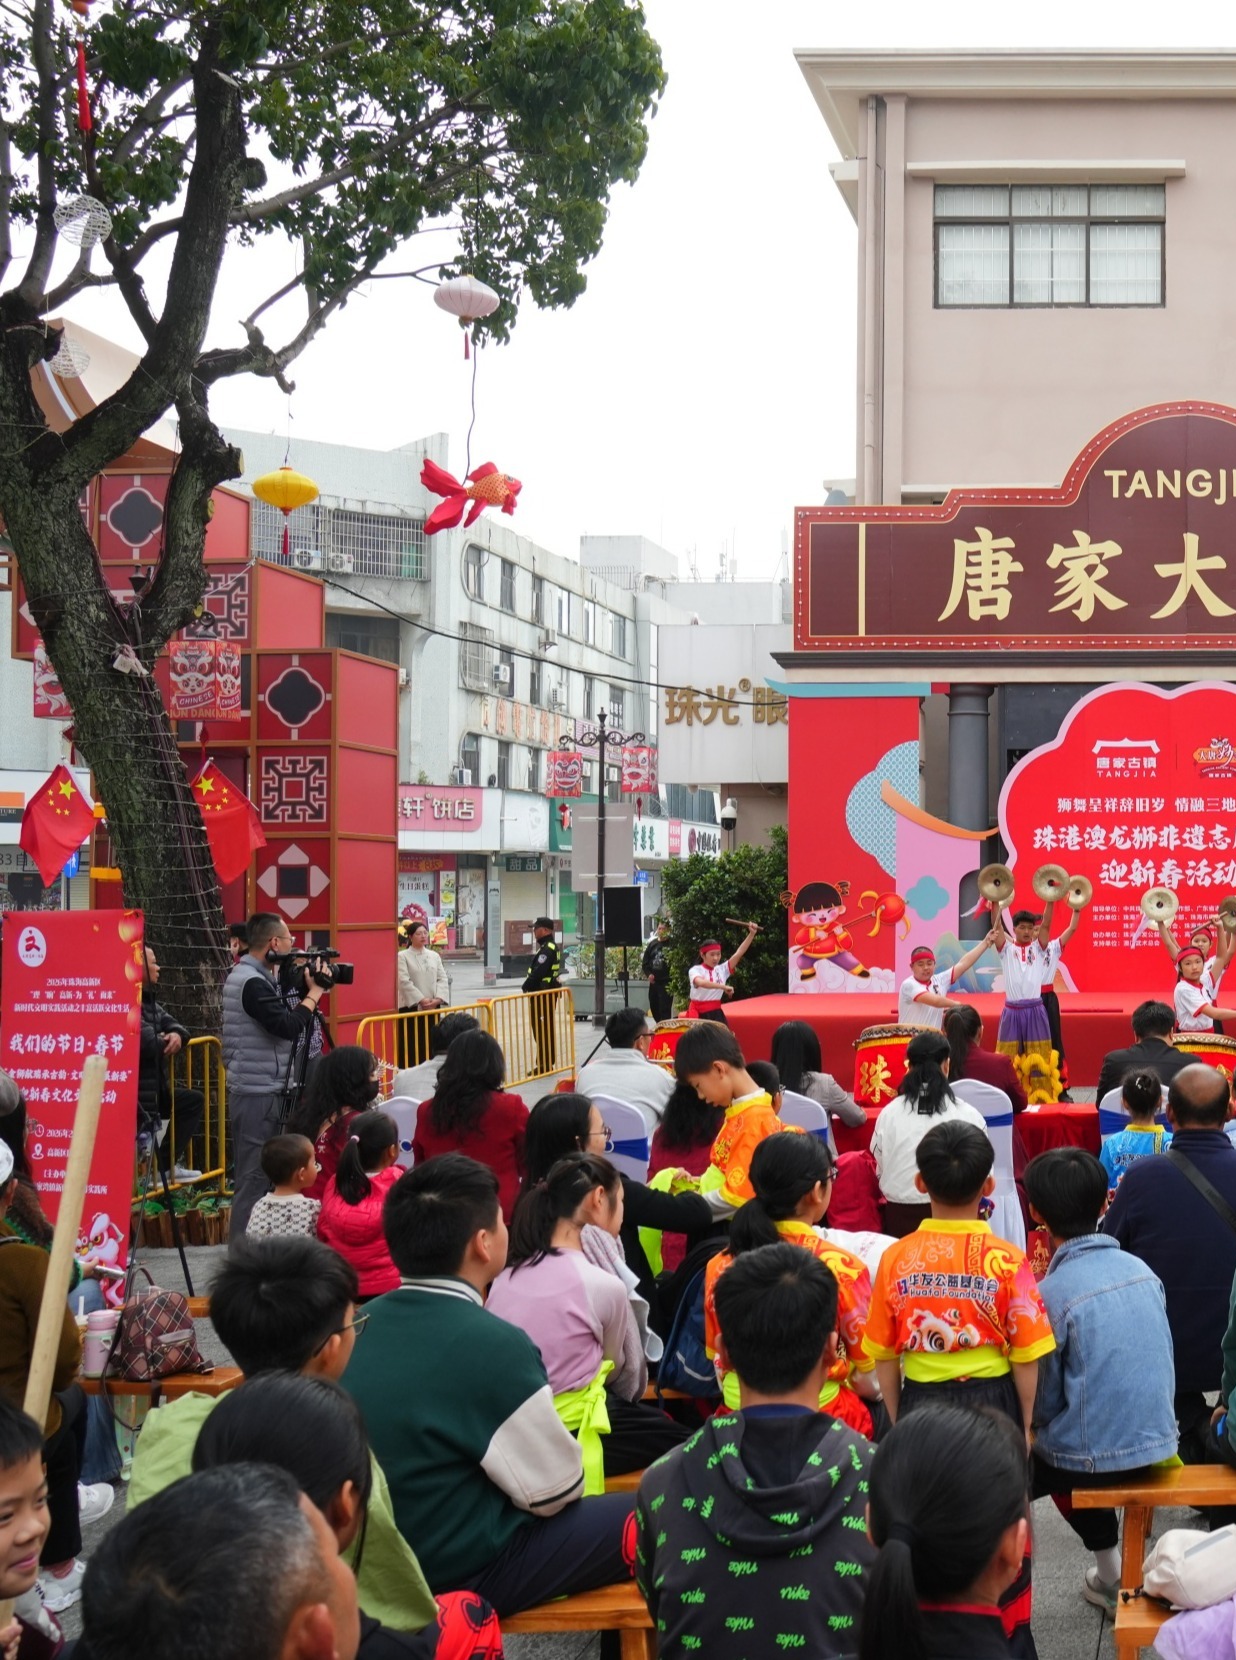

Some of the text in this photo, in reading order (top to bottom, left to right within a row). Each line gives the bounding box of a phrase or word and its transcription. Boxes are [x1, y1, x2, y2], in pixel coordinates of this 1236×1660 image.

[1096, 757, 1157, 769] 唐家古镇
[1096, 770, 1157, 778] TANGJIA
[1057, 797, 1165, 813] 狮舞呈祥辞旧岁
[510, 858, 538, 871] 甜品
[9, 1033, 124, 1056] 我们的节日·春节
[860, 1054, 898, 1103] 珠
[909, 1273, 999, 1293] 华发公益基金会
